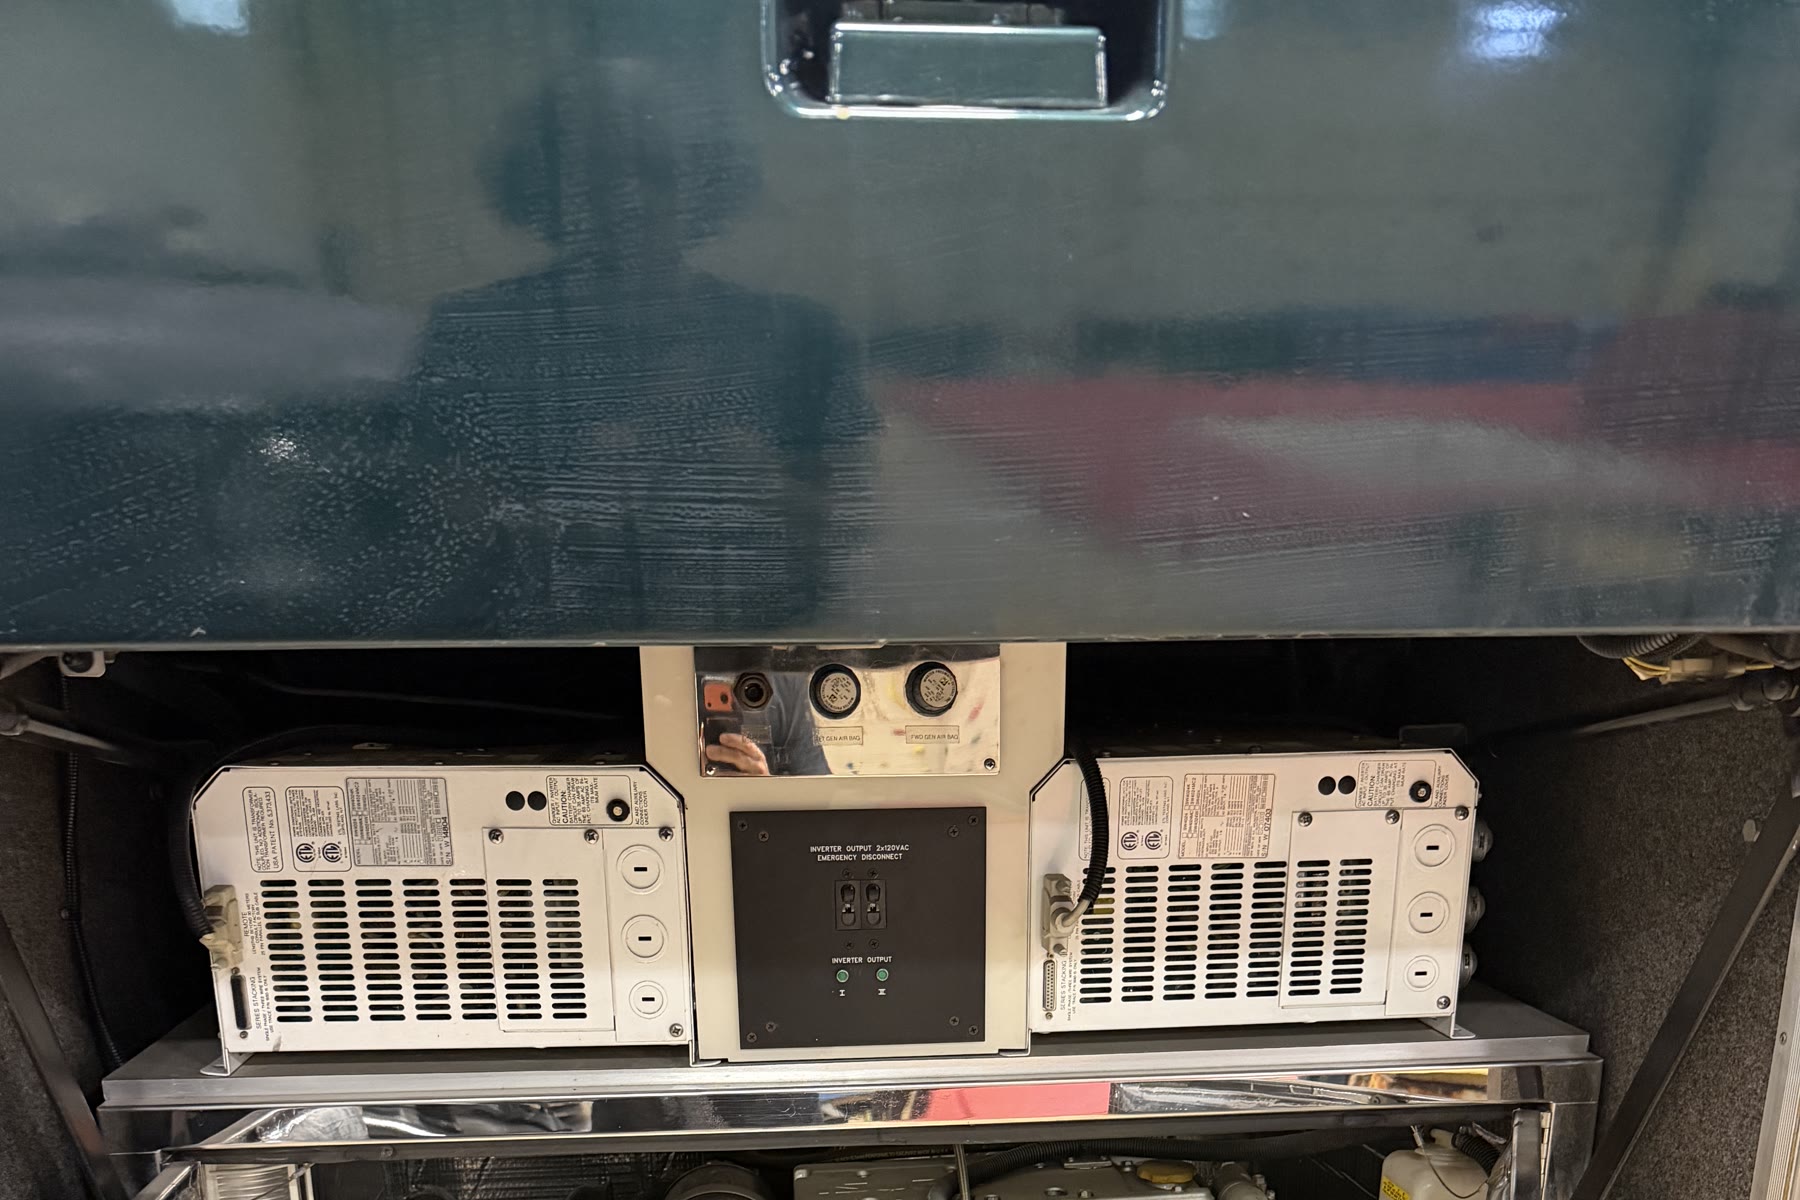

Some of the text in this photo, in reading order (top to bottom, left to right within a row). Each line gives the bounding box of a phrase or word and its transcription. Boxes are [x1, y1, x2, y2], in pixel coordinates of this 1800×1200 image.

[1264, 809, 1272, 832] 07403
[817, 854, 857, 862] EMERGENCY
[250, 977, 262, 1029] SERIES STACKING
